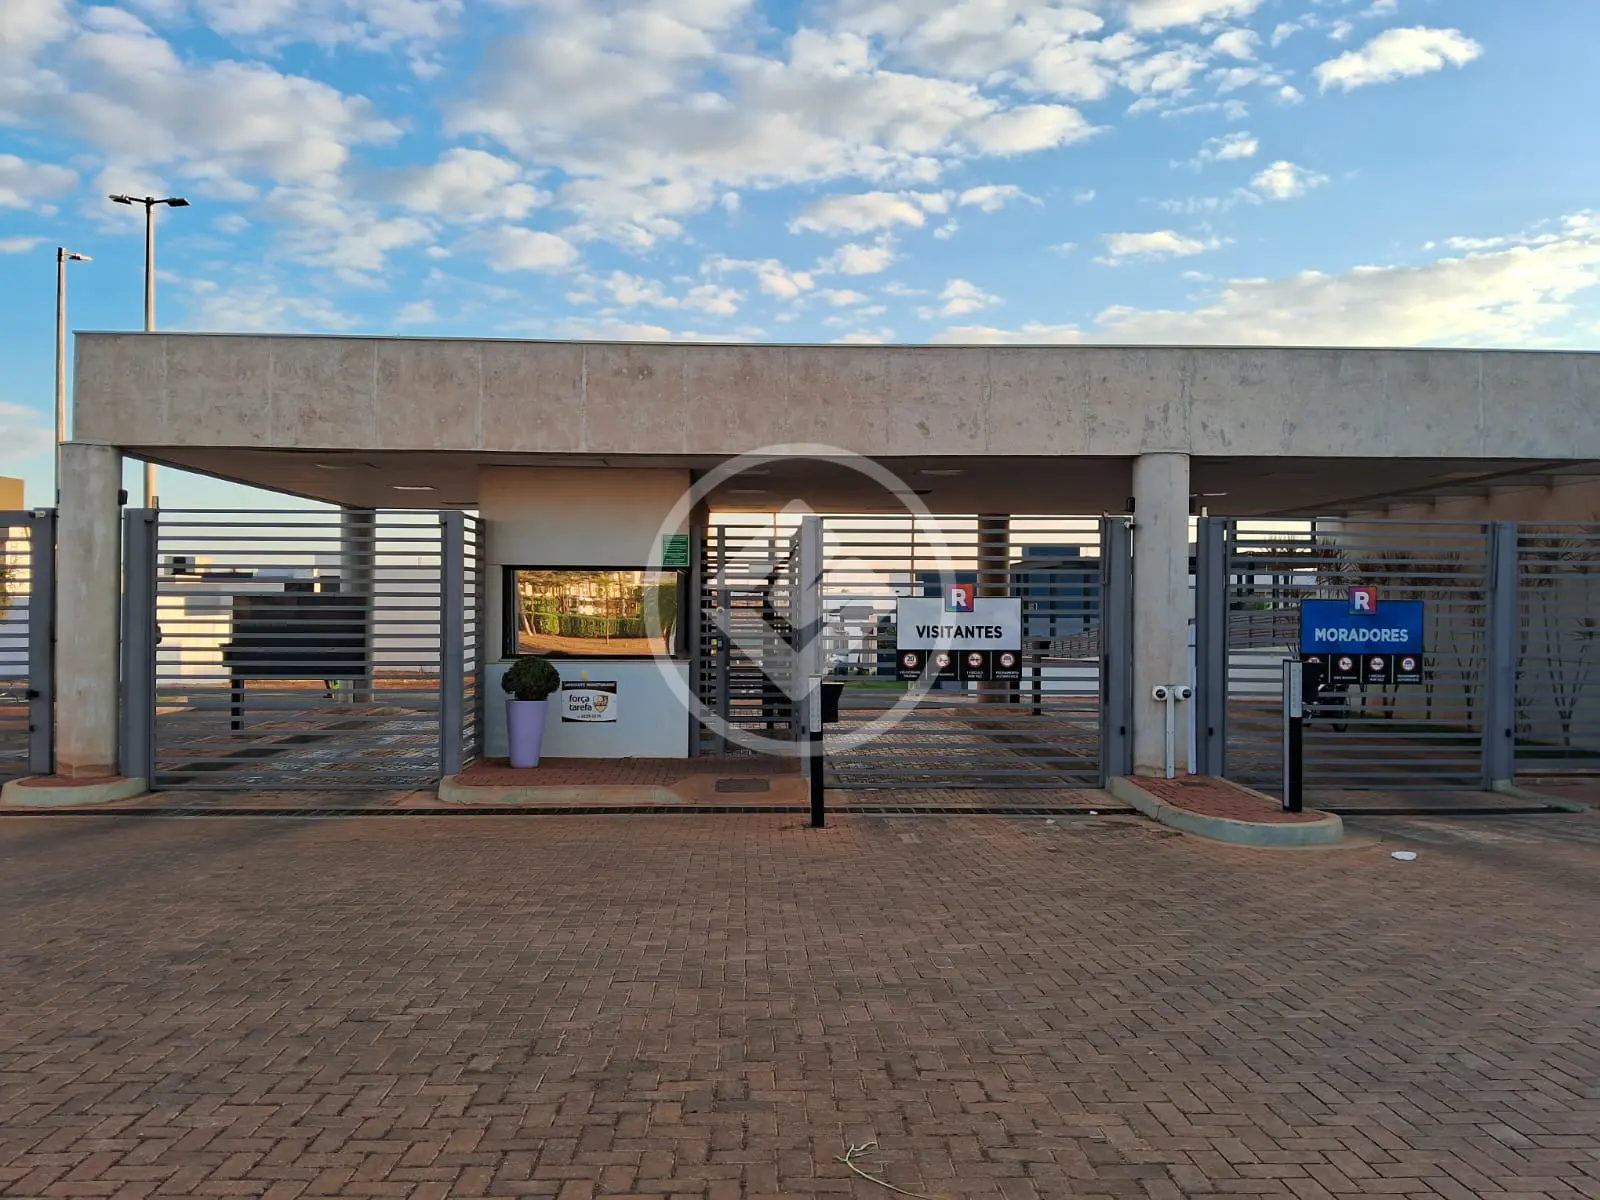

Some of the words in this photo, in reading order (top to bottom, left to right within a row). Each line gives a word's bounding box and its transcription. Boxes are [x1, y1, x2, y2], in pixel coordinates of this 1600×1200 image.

[952, 588, 966, 606] R
[1354, 592, 1370, 610] R
[916, 625, 1002, 638] VISITANTES
[1314, 628, 1408, 642] MORADORES
[569, 694, 590, 703] força
[569, 703, 592, 711] tarefa
